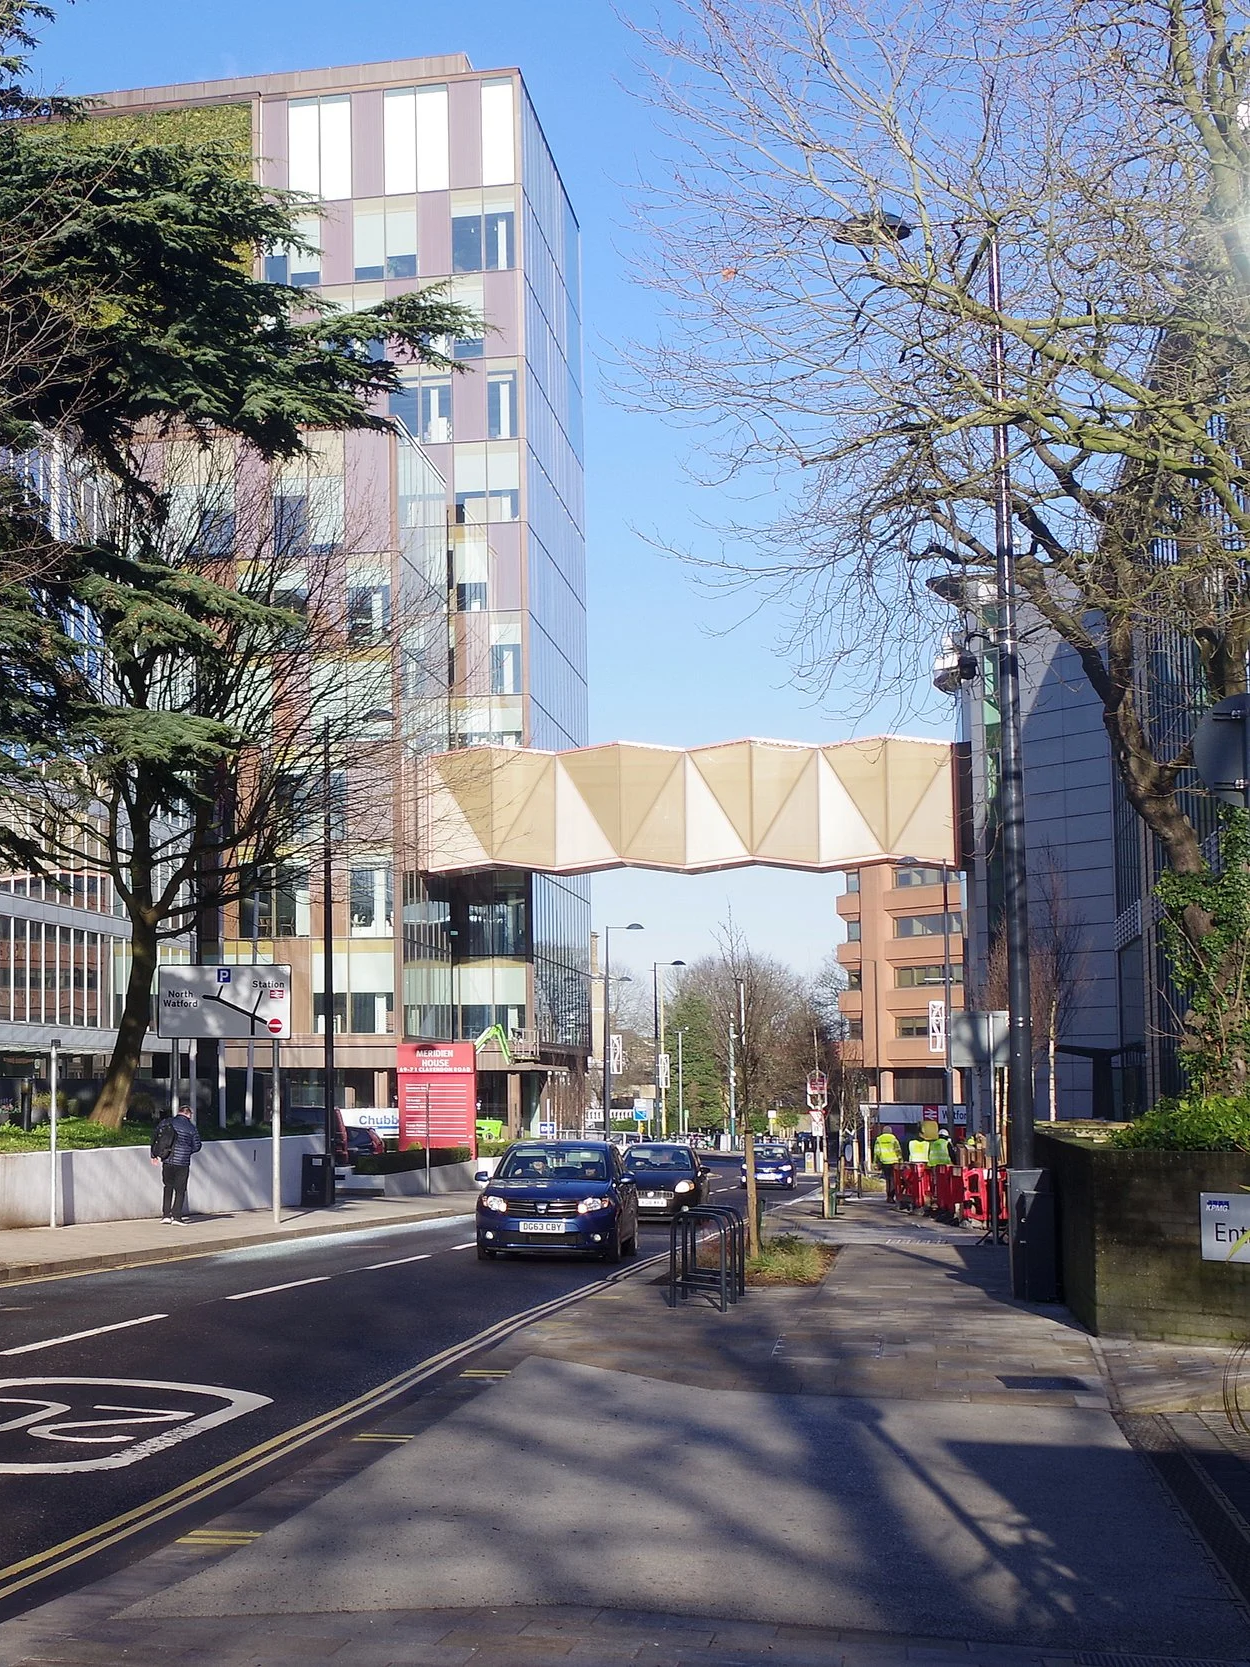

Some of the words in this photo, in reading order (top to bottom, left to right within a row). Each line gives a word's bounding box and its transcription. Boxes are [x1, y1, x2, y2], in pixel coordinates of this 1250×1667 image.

[252, 980, 285, 989] Station
[168, 990, 194, 998] North
[163, 999, 198, 1008] Watford
[415, 1049, 454, 1058] MERIDIEN
[421, 1059, 450, 1067] HOUSE
[358, 1115, 399, 1125] Chubb
[1215, 1222, 1250, 1244] Ent
